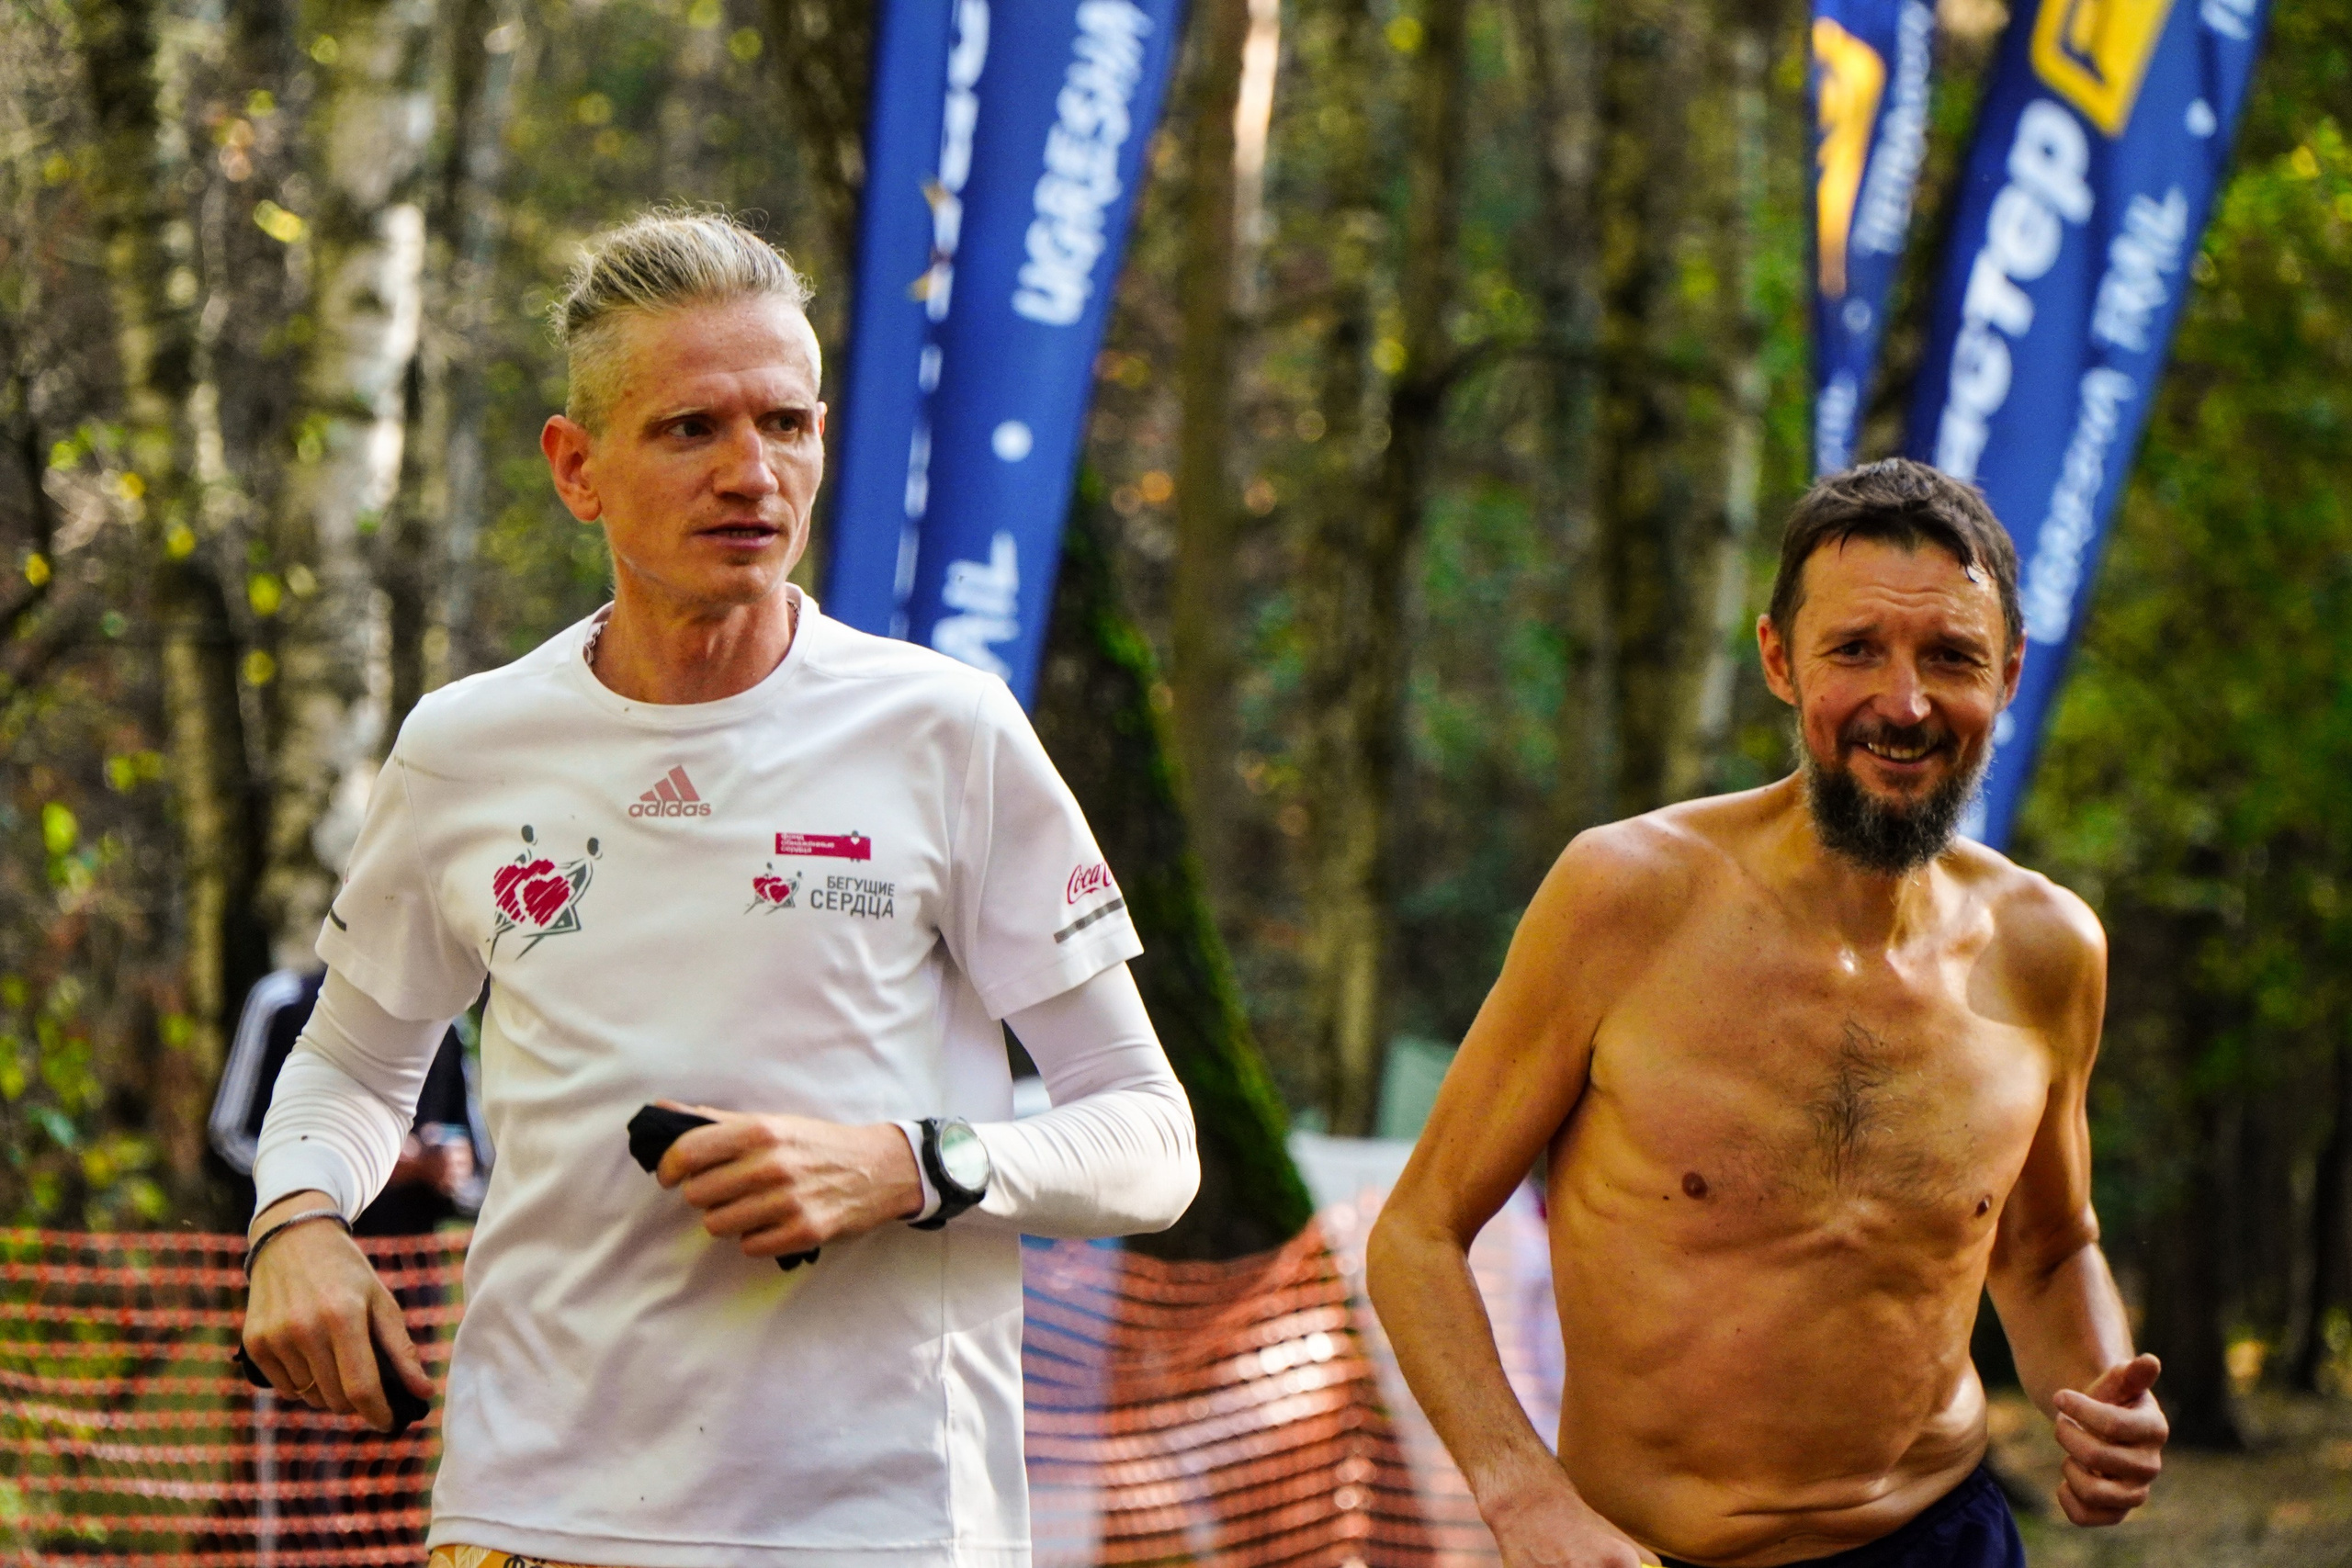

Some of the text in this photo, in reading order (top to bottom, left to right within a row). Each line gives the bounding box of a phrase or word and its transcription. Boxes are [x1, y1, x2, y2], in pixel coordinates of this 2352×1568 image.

[628, 800, 712, 818] adidas
[827, 875, 896, 897] БЕГУЩИЕ
[810, 889, 894, 919] СЕРДЦА
